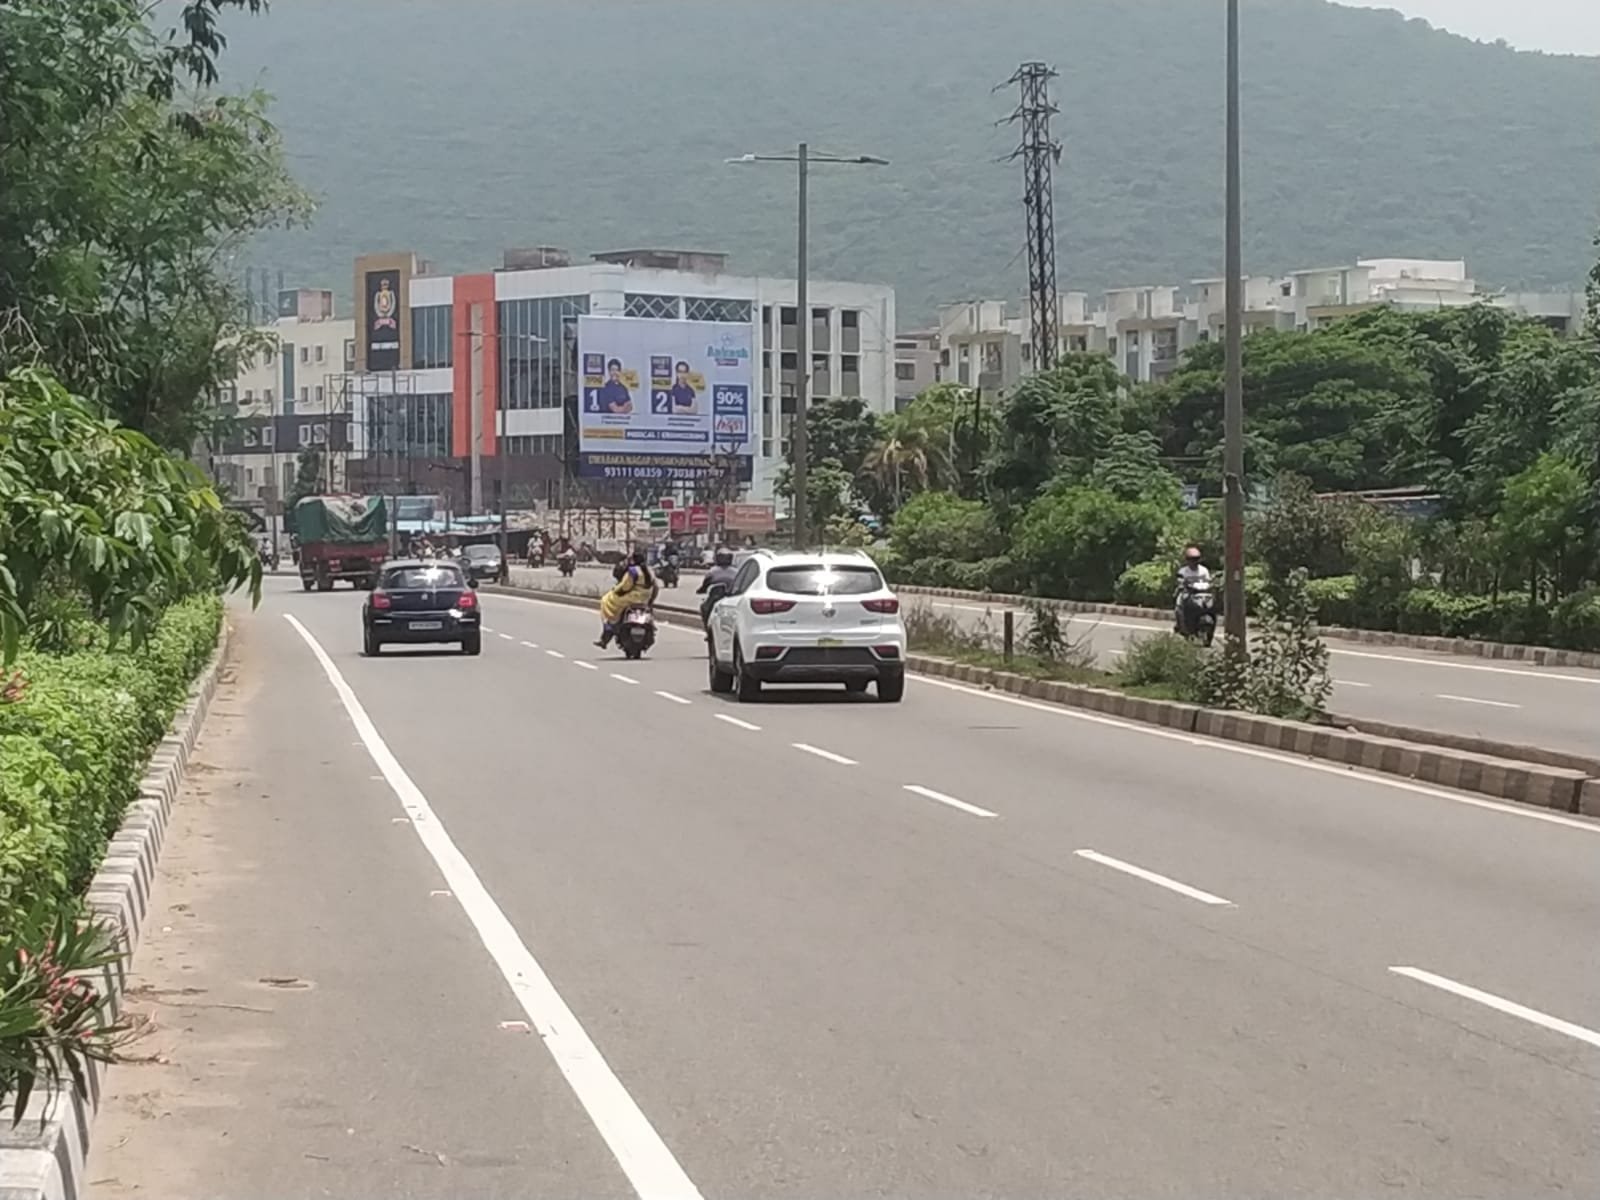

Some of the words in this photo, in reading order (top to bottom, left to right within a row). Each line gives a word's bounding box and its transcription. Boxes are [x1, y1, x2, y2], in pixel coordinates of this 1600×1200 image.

[589, 390, 600, 411] 1
[656, 391, 669, 413] 2
[716, 392, 744, 405] 90%
